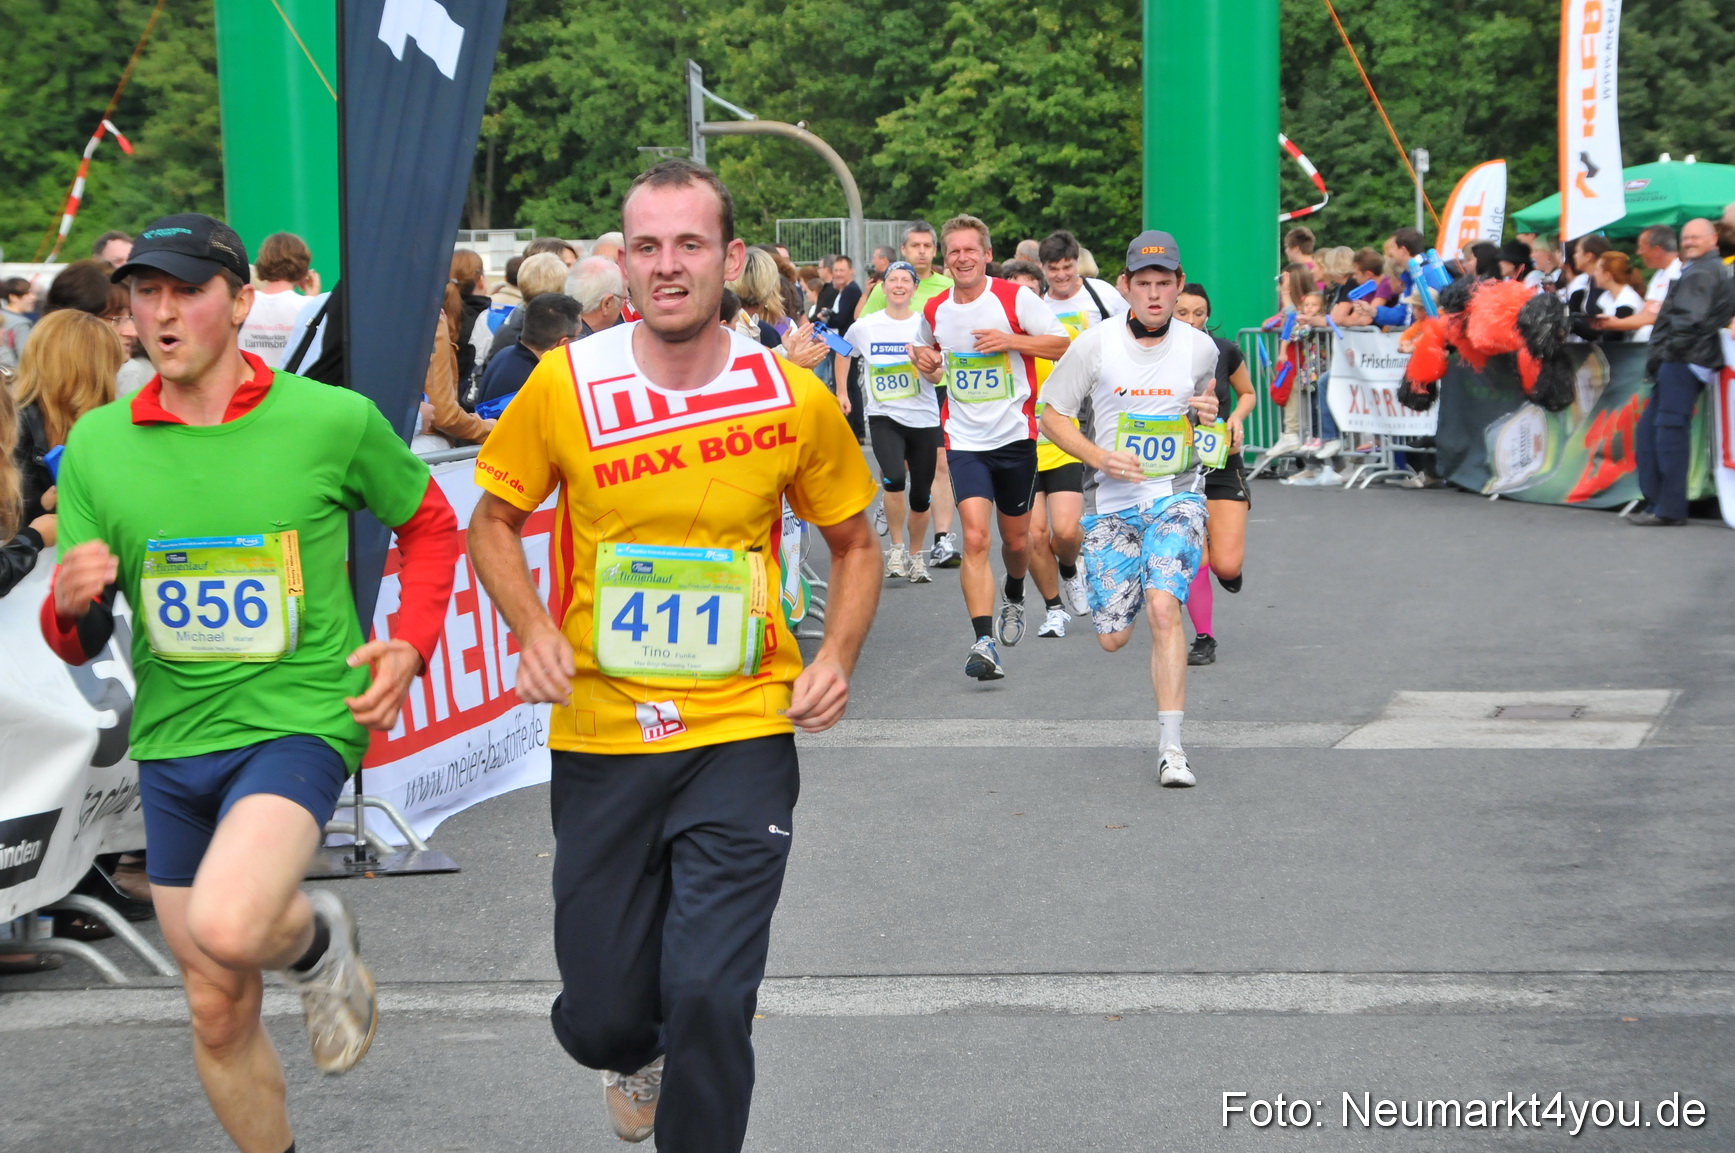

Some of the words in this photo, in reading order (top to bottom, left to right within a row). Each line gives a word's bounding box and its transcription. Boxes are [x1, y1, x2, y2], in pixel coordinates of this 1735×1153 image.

[876, 373, 909, 392] 880
[956, 368, 999, 390] 875
[1130, 388, 1176, 397] KLEBL
[593, 444, 688, 489] MAX
[698, 421, 797, 464] BÖGL
[1125, 435, 1176, 462] 509
[618, 571, 673, 585] firmenlauf
[157, 578, 269, 630] 856
[611, 591, 721, 646] 411
[176, 631, 225, 643] Michael
[641, 645, 671, 659] Tino
[403, 703, 545, 811] www.meier-baustoffe.de
